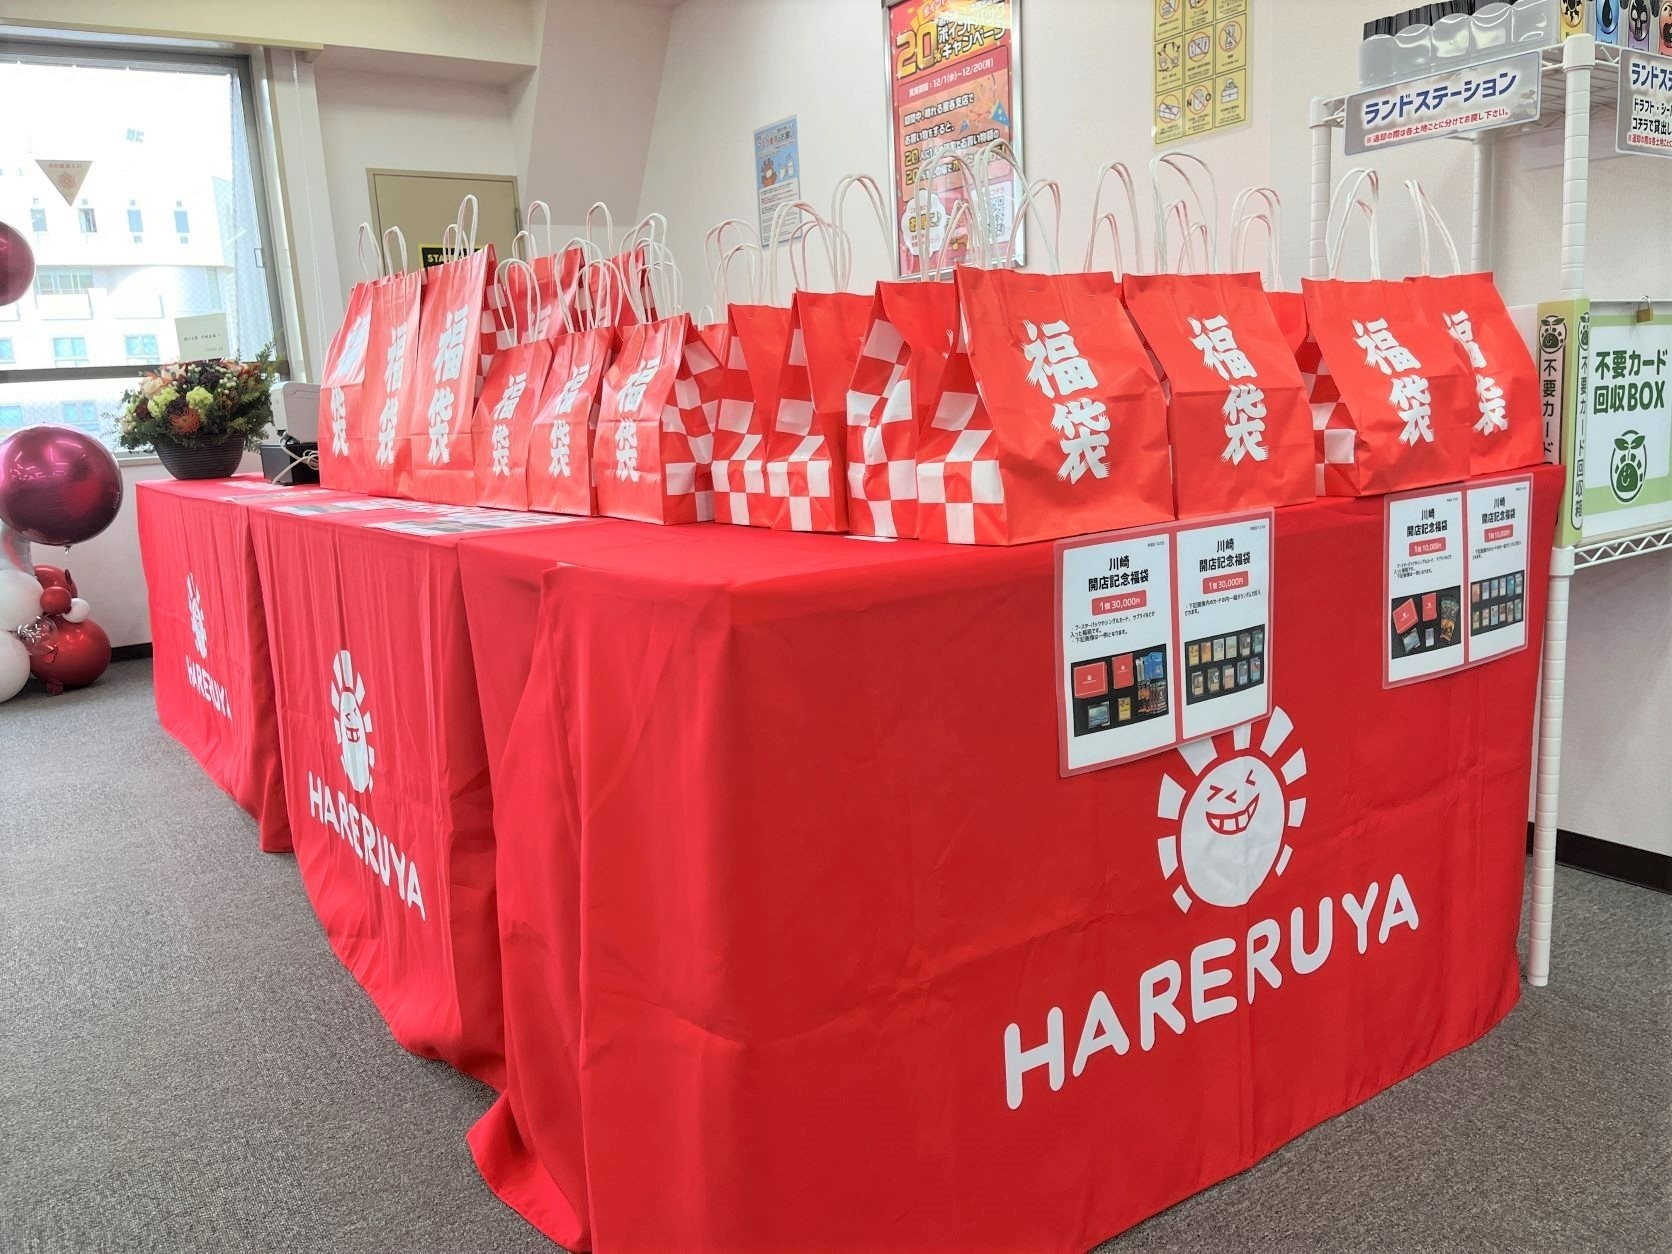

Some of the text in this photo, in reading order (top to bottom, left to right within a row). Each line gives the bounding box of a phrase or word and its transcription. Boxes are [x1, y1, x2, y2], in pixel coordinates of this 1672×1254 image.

[1365, 72, 1517, 125] ランドステーション
[1634, 97, 1672, 117] ドラフト・シー
[376, 321, 408, 466] 福袋
[428, 304, 469, 466] 福袋
[1021, 318, 1112, 485] 福袋
[1187, 314, 1269, 467] 福袋
[1352, 317, 1435, 447] 福袋
[1543, 359, 1557, 465] 不要カード
[1593, 381, 1666, 415] 回収BOX
[1595, 349, 1668, 380] 不要カード
[492, 371, 527, 478] 福袋
[550, 362, 591, 478] 福袋
[615, 356, 660, 483] 福袋
[1088, 569, 1149, 592] 開店記念福袋
[1109, 555, 1130, 571] 川崎
[1199, 552, 1251, 572] 開店記念福袋
[1216, 538, 1234, 553] 川崎
[1407, 520, 1448, 537] 開店記念福袋
[308, 770, 426, 922] HARERUYA
[1004, 873, 1419, 1110] HARERUYA
